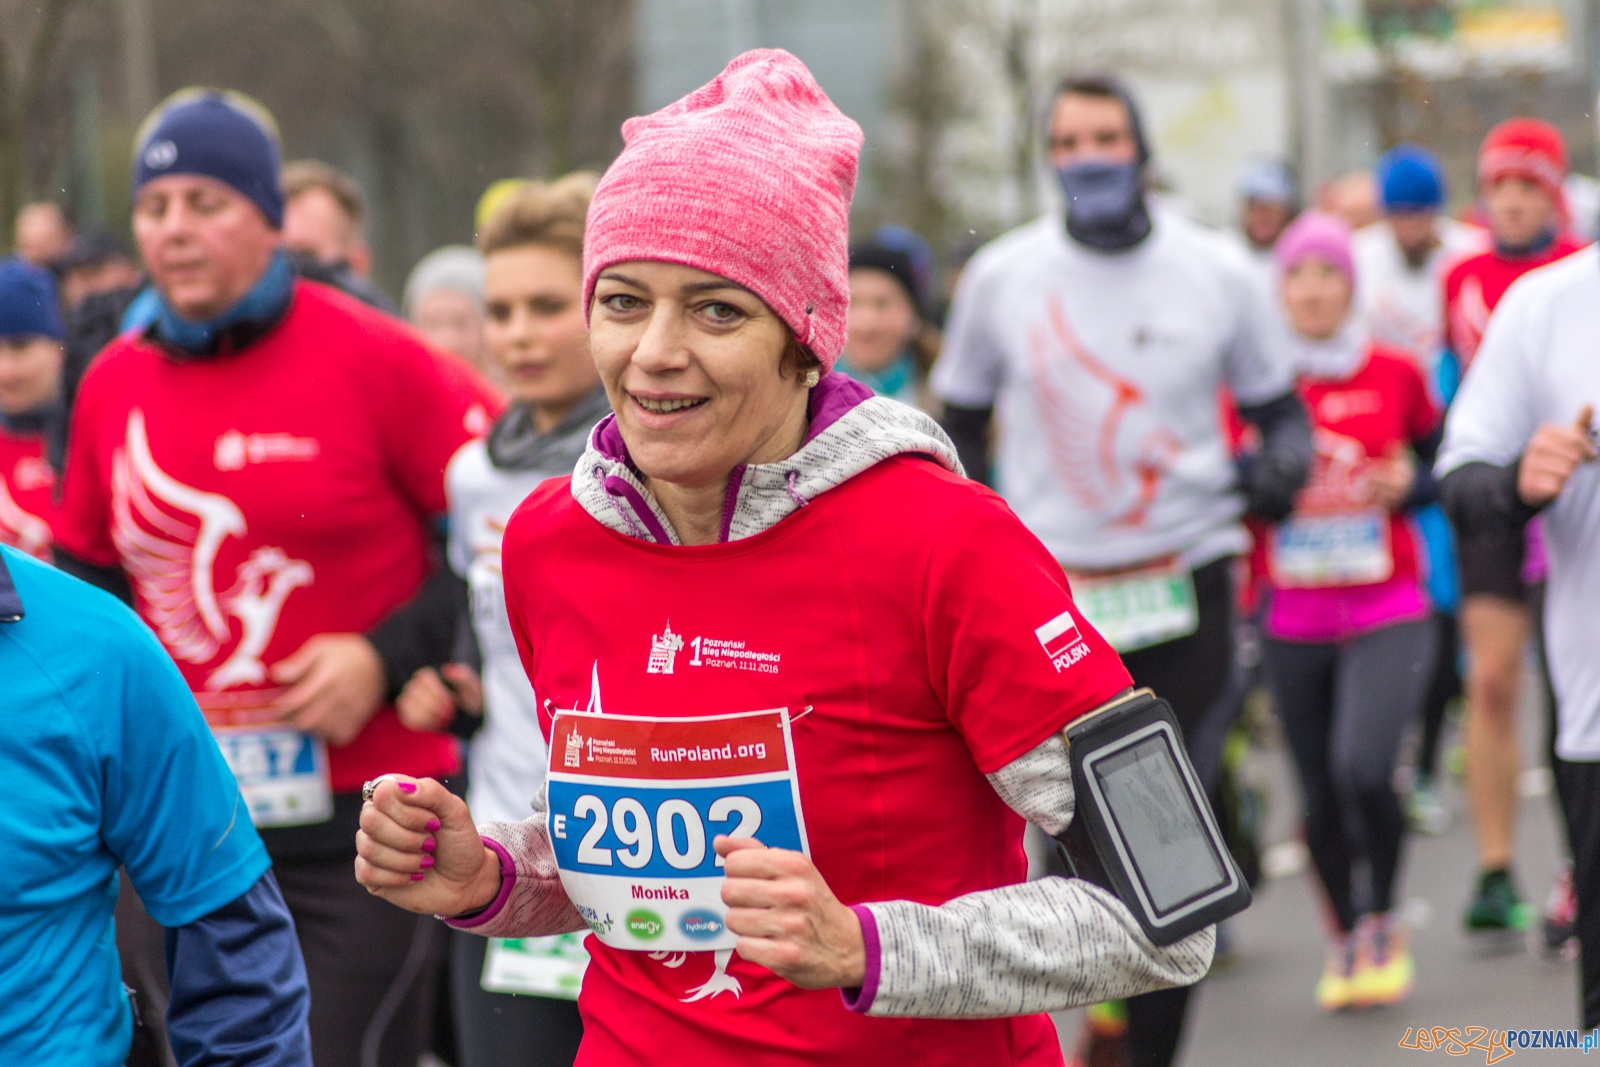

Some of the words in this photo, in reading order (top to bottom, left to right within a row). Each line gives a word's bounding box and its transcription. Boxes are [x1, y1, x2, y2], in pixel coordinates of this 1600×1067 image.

[690, 636, 702, 666] 1
[702, 647, 720, 657] Bieg
[721, 648, 781, 662] Niepodległości
[703, 638, 745, 649] Poznański
[1052, 642, 1091, 673] POLSKA
[586, 736, 594, 762] 1
[651, 742, 767, 762] RunPoland.org
[553, 813, 567, 839] E
[573, 793, 763, 870] 2902
[631, 884, 690, 900] Monika
[631, 920, 660, 934] energy
